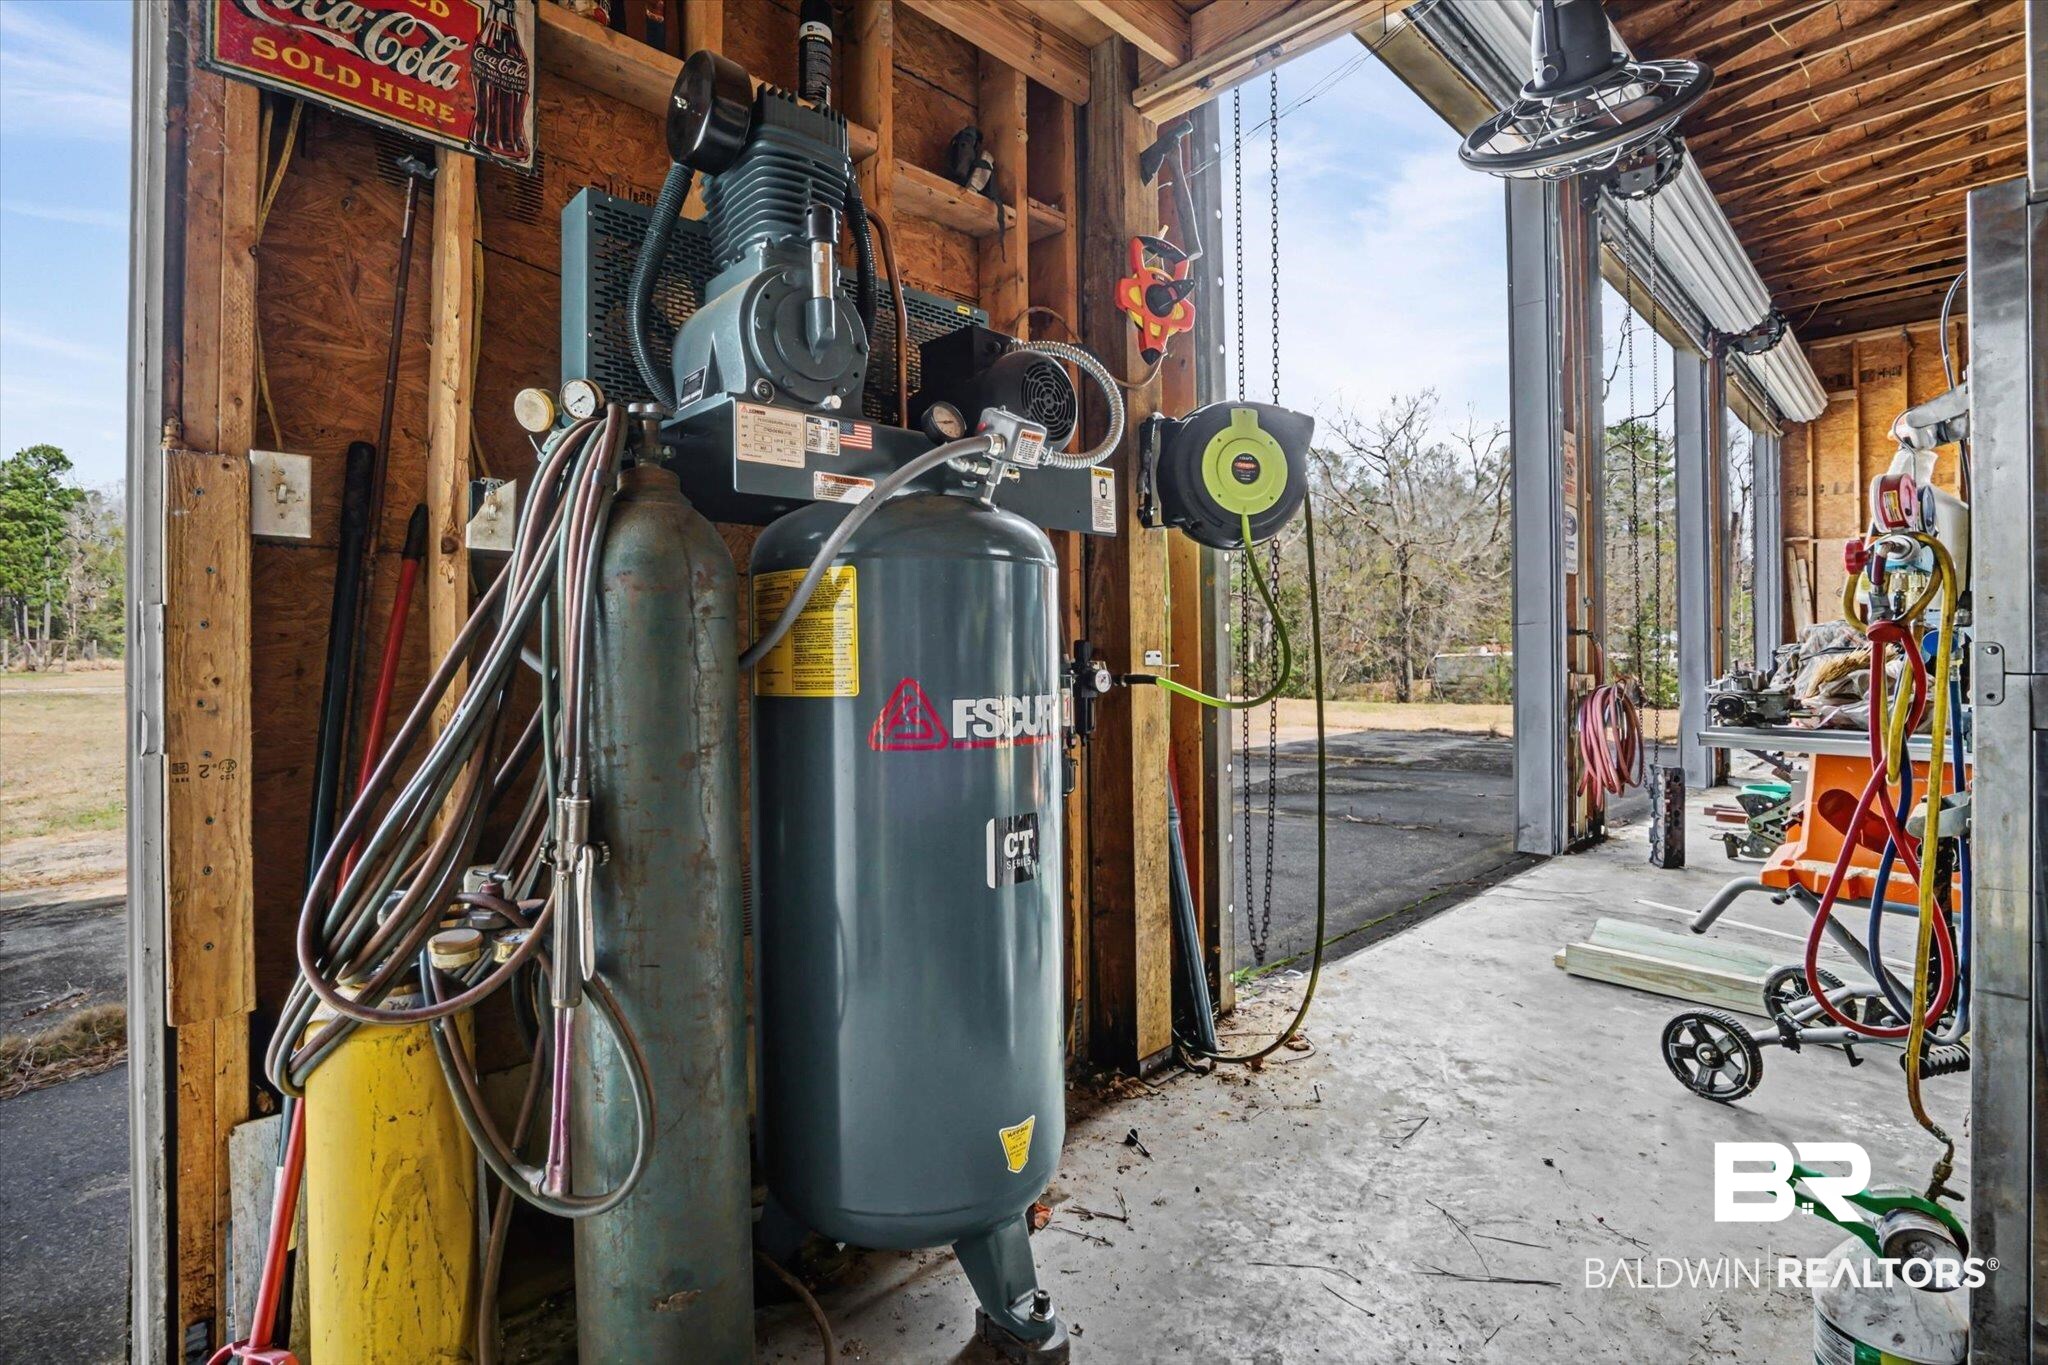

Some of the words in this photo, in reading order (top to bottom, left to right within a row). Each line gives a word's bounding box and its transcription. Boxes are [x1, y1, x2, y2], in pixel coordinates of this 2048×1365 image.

[252, 36, 362, 89] SOLD
[372, 77, 456, 123] HERE
[1003, 828, 1034, 858] CT
